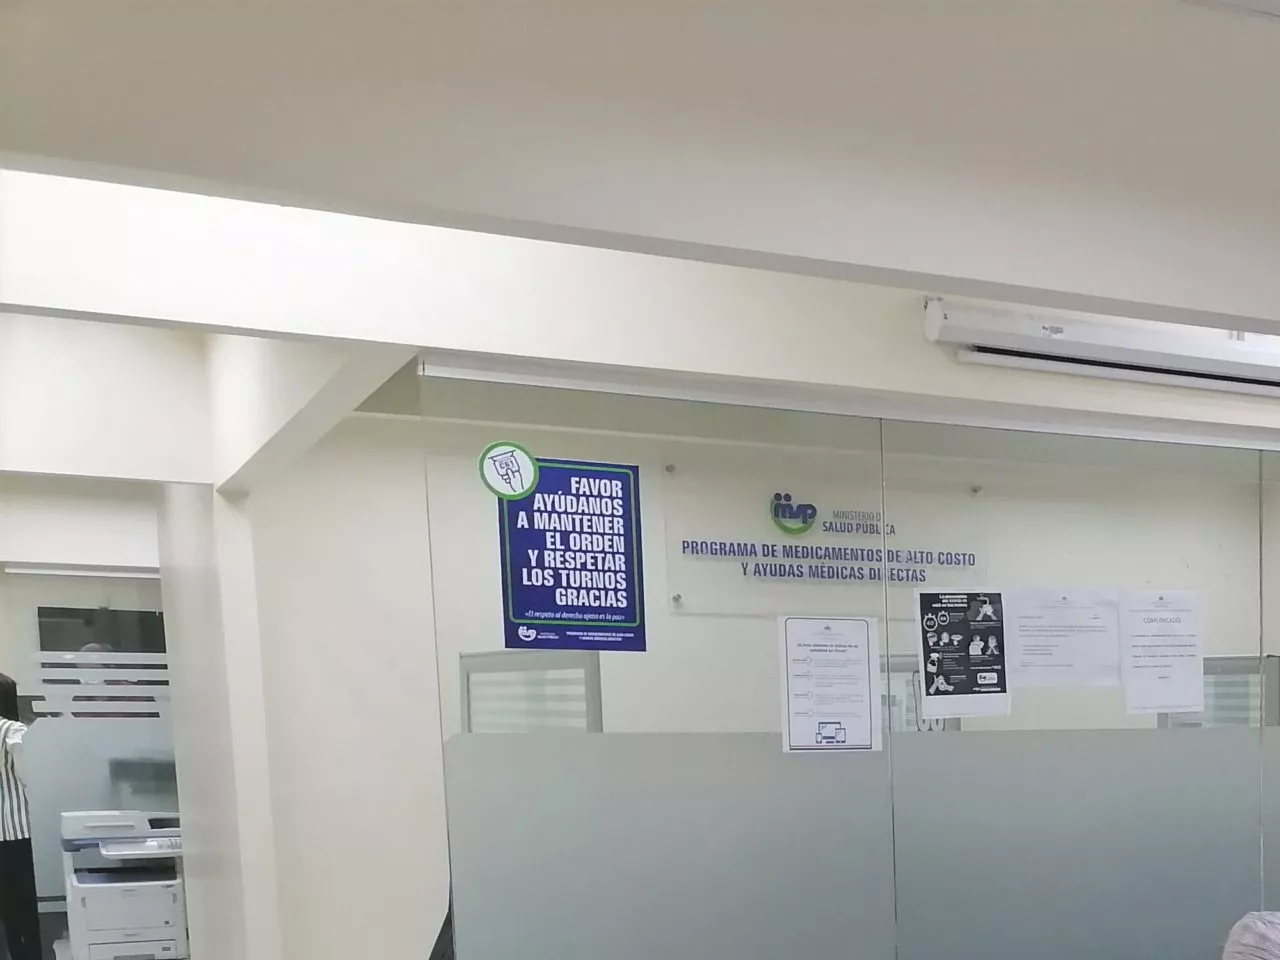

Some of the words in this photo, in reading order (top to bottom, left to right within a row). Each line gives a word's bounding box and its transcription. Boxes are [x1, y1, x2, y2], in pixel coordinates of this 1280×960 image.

[570, 477, 623, 497] FAVOR
[533, 490, 624, 516] AYÚDANOS
[517, 511, 529, 529] A
[533, 512, 624, 534] MANTENER
[832, 509, 873, 521] MINISTERIO
[823, 520, 853, 533] SALUD
[855, 521, 896, 536] PÚBLCA
[546, 531, 565, 550] EL
[569, 533, 625, 553] ORDEN
[682, 540, 757, 557] PROGRAMA
[761, 544, 777, 558] DE
[782, 545, 882, 562] MEDICAMENTOS
[887, 549, 902, 563] DE
[905, 550, 933, 564] ALTO
[938, 551, 976, 566] COSTO
[528, 549, 539, 567] Y
[544, 550, 626, 571] RESPETAR
[522, 568, 554, 587] LOS
[559, 569, 626, 590] TURNOS
[741, 562, 748, 576] Y
[753, 563, 803, 578] AYUDAS
[808, 561, 864, 581] MÉDICAS
[869, 567, 926, 583] DIECTAS
[555, 588, 628, 608] GRACIAS
